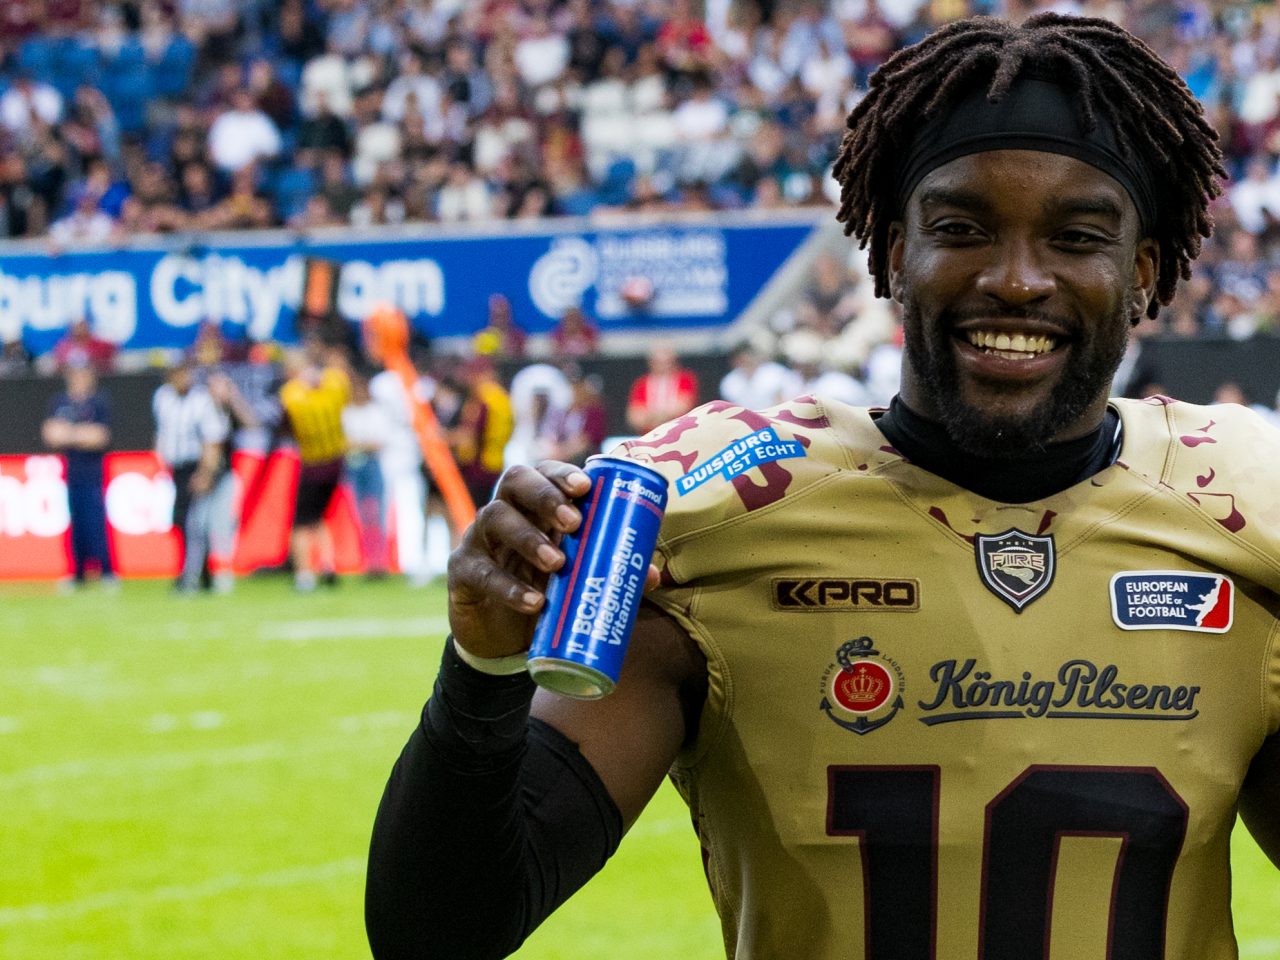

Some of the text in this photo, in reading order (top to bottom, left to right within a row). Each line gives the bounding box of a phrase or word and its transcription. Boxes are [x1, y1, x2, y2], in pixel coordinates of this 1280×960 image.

[681, 430, 772, 490] DUISBURG
[726, 443, 796, 475] IST ECHT
[591, 526, 638, 642] Magnesium
[987, 552, 1046, 572] FIRE
[571, 576, 606, 636] BCAA
[608, 552, 645, 646] Vitamin D
[1125, 581, 1189, 593] EUROPEAN
[1127, 594, 1173, 606] LEAGUE
[1128, 606, 1188, 618] FOOTBALL
[917, 658, 1201, 718] König Pilsener
